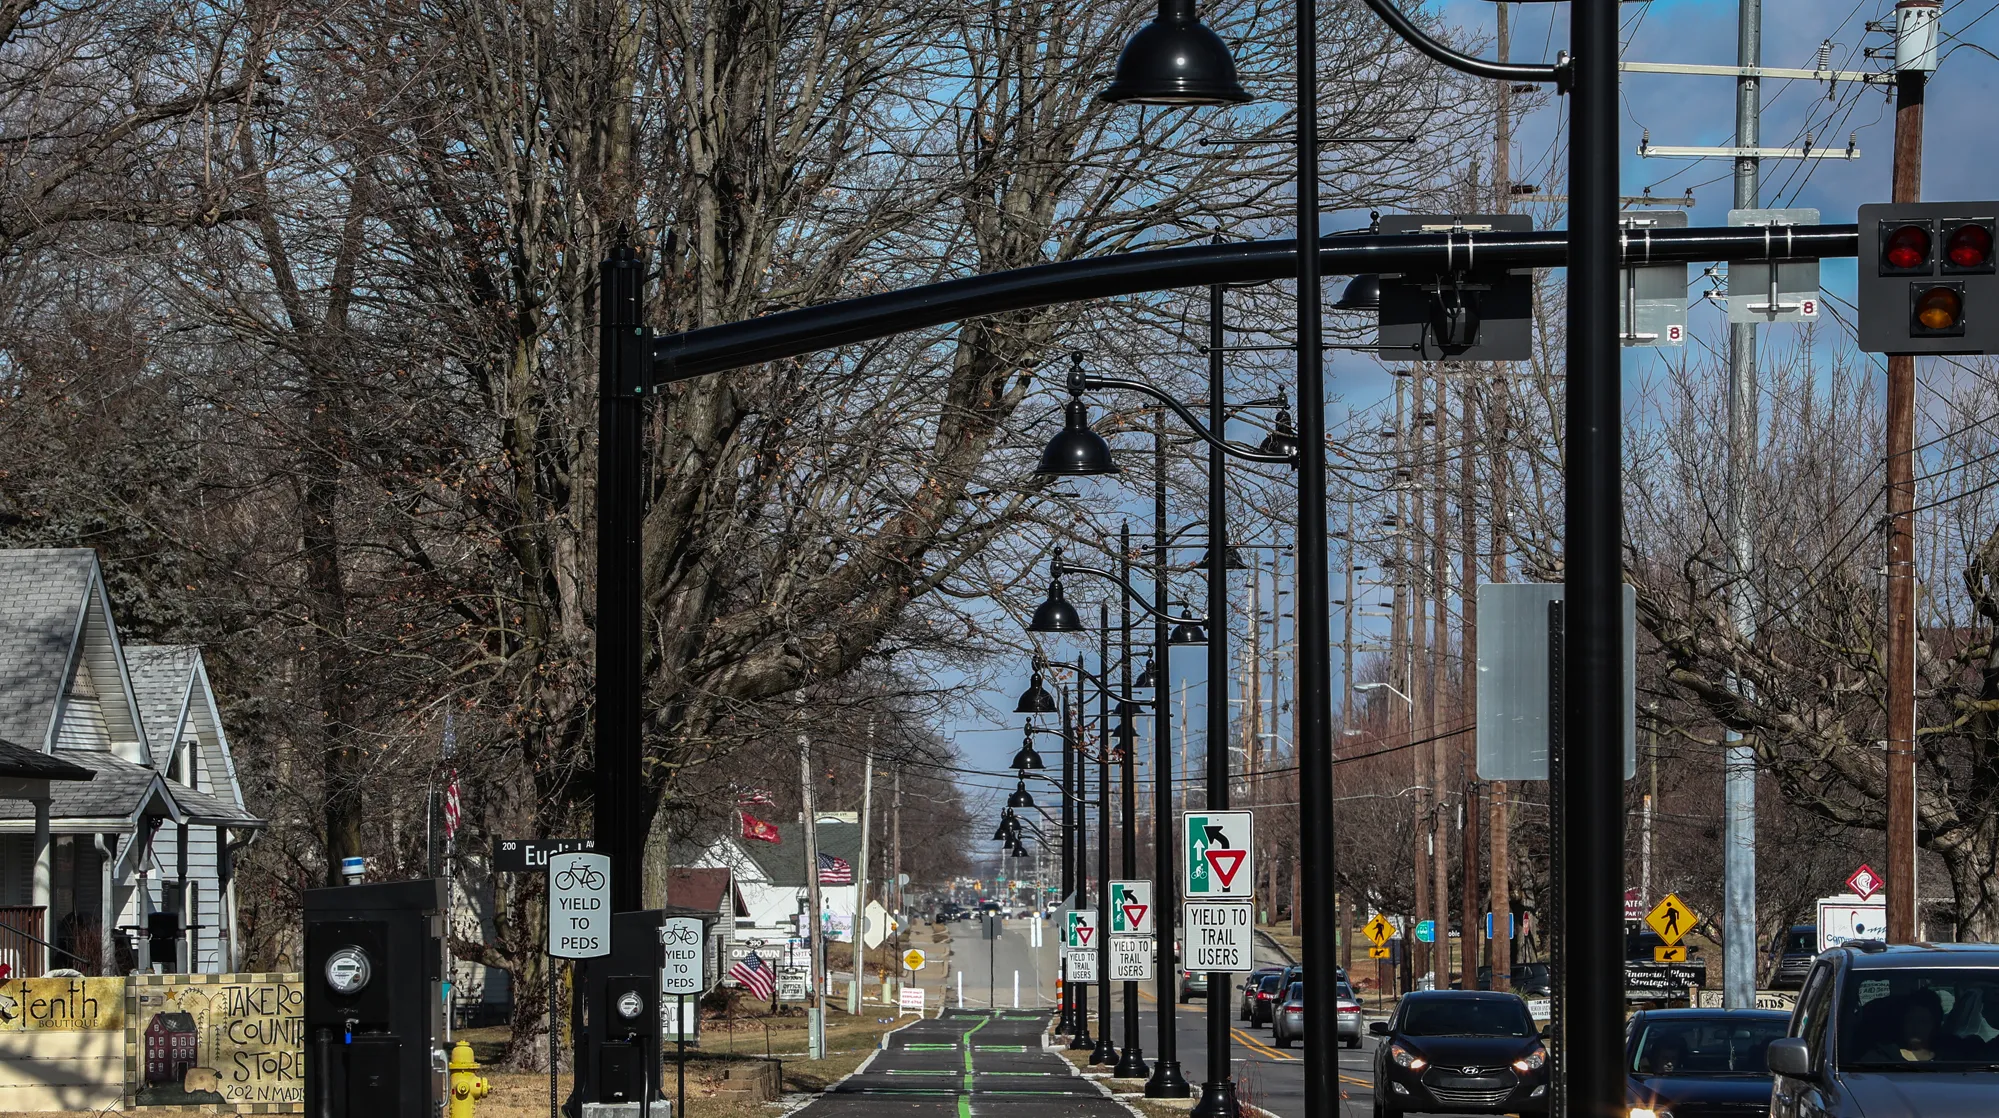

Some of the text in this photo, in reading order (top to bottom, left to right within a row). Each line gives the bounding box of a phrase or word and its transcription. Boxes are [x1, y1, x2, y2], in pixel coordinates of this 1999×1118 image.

[1804, 302, 1813, 314] 8
[1670, 327, 1679, 340] 8
[502, 842, 516, 850] 200
[559, 898, 601, 910] YIELD
[1191, 909, 1246, 925] YIELD TO
[570, 917, 590, 930] TO
[1201, 928, 1236, 945] TRAIL
[561, 937, 599, 950] PEDS
[1114, 941, 1148, 951] YIELD TO
[665, 950, 696, 960] YIELD
[1120, 953, 1142, 964] TRAIL
[1198, 948, 1239, 965] USERS
[673, 964, 688, 974] TO
[1074, 962, 1090, 970] TRAIL
[1118, 966, 1144, 976] USERS
[1073, 971, 1091, 979] USERS
[1670, 970, 1695, 978] Plans
[667, 978, 695, 988] PEDS
[1756, 999, 1784, 1008] AIDS
[38, 1020, 98, 1029] BOUTIQUE
[234, 1051, 304, 1081] STORE
[227, 1085, 253, 1099] 202
